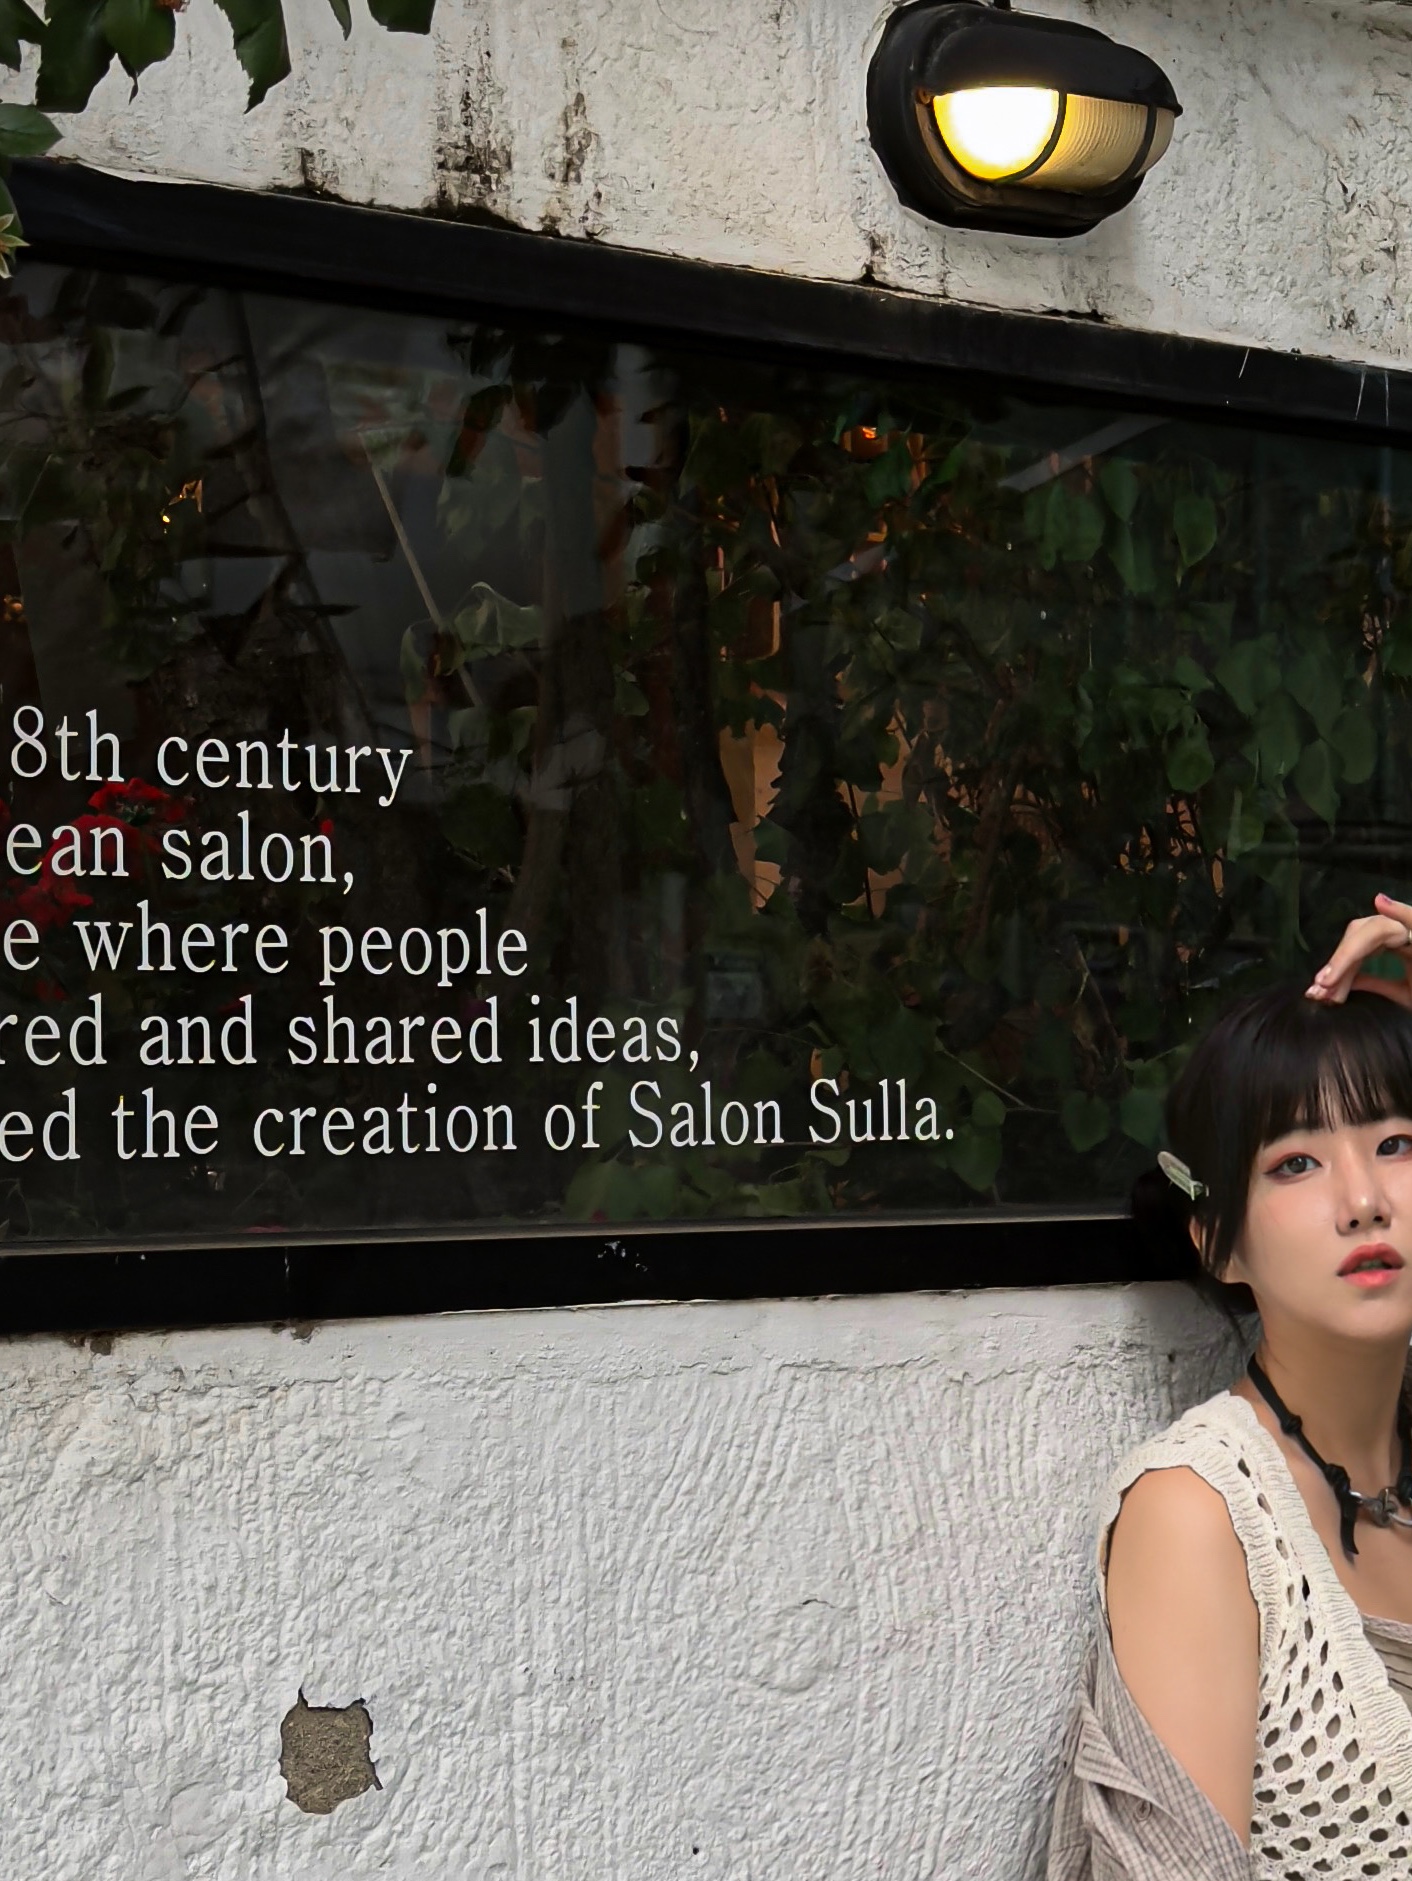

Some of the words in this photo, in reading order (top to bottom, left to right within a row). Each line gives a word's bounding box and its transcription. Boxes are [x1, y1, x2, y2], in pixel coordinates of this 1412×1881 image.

[11, 705, 125, 783] 8th
[157, 727, 413, 807] century
[6, 823, 129, 876] ean
[161, 810, 354, 895] salon,
[3, 919, 40, 971] e
[73, 900, 289, 973] where
[318, 907, 528, 987] people
[139, 993, 257, 1066] and
[288, 995, 502, 1065] shared
[529, 994, 699, 1072] ideas,
[0, 1087, 81, 1162] ed
[111, 1087, 219, 1160] the
[253, 1083, 518, 1157] creation
[545, 1081, 604, 1151] of
[628, 1080, 785, 1147] Salon
[808, 1079, 954, 1144] Sulla.
